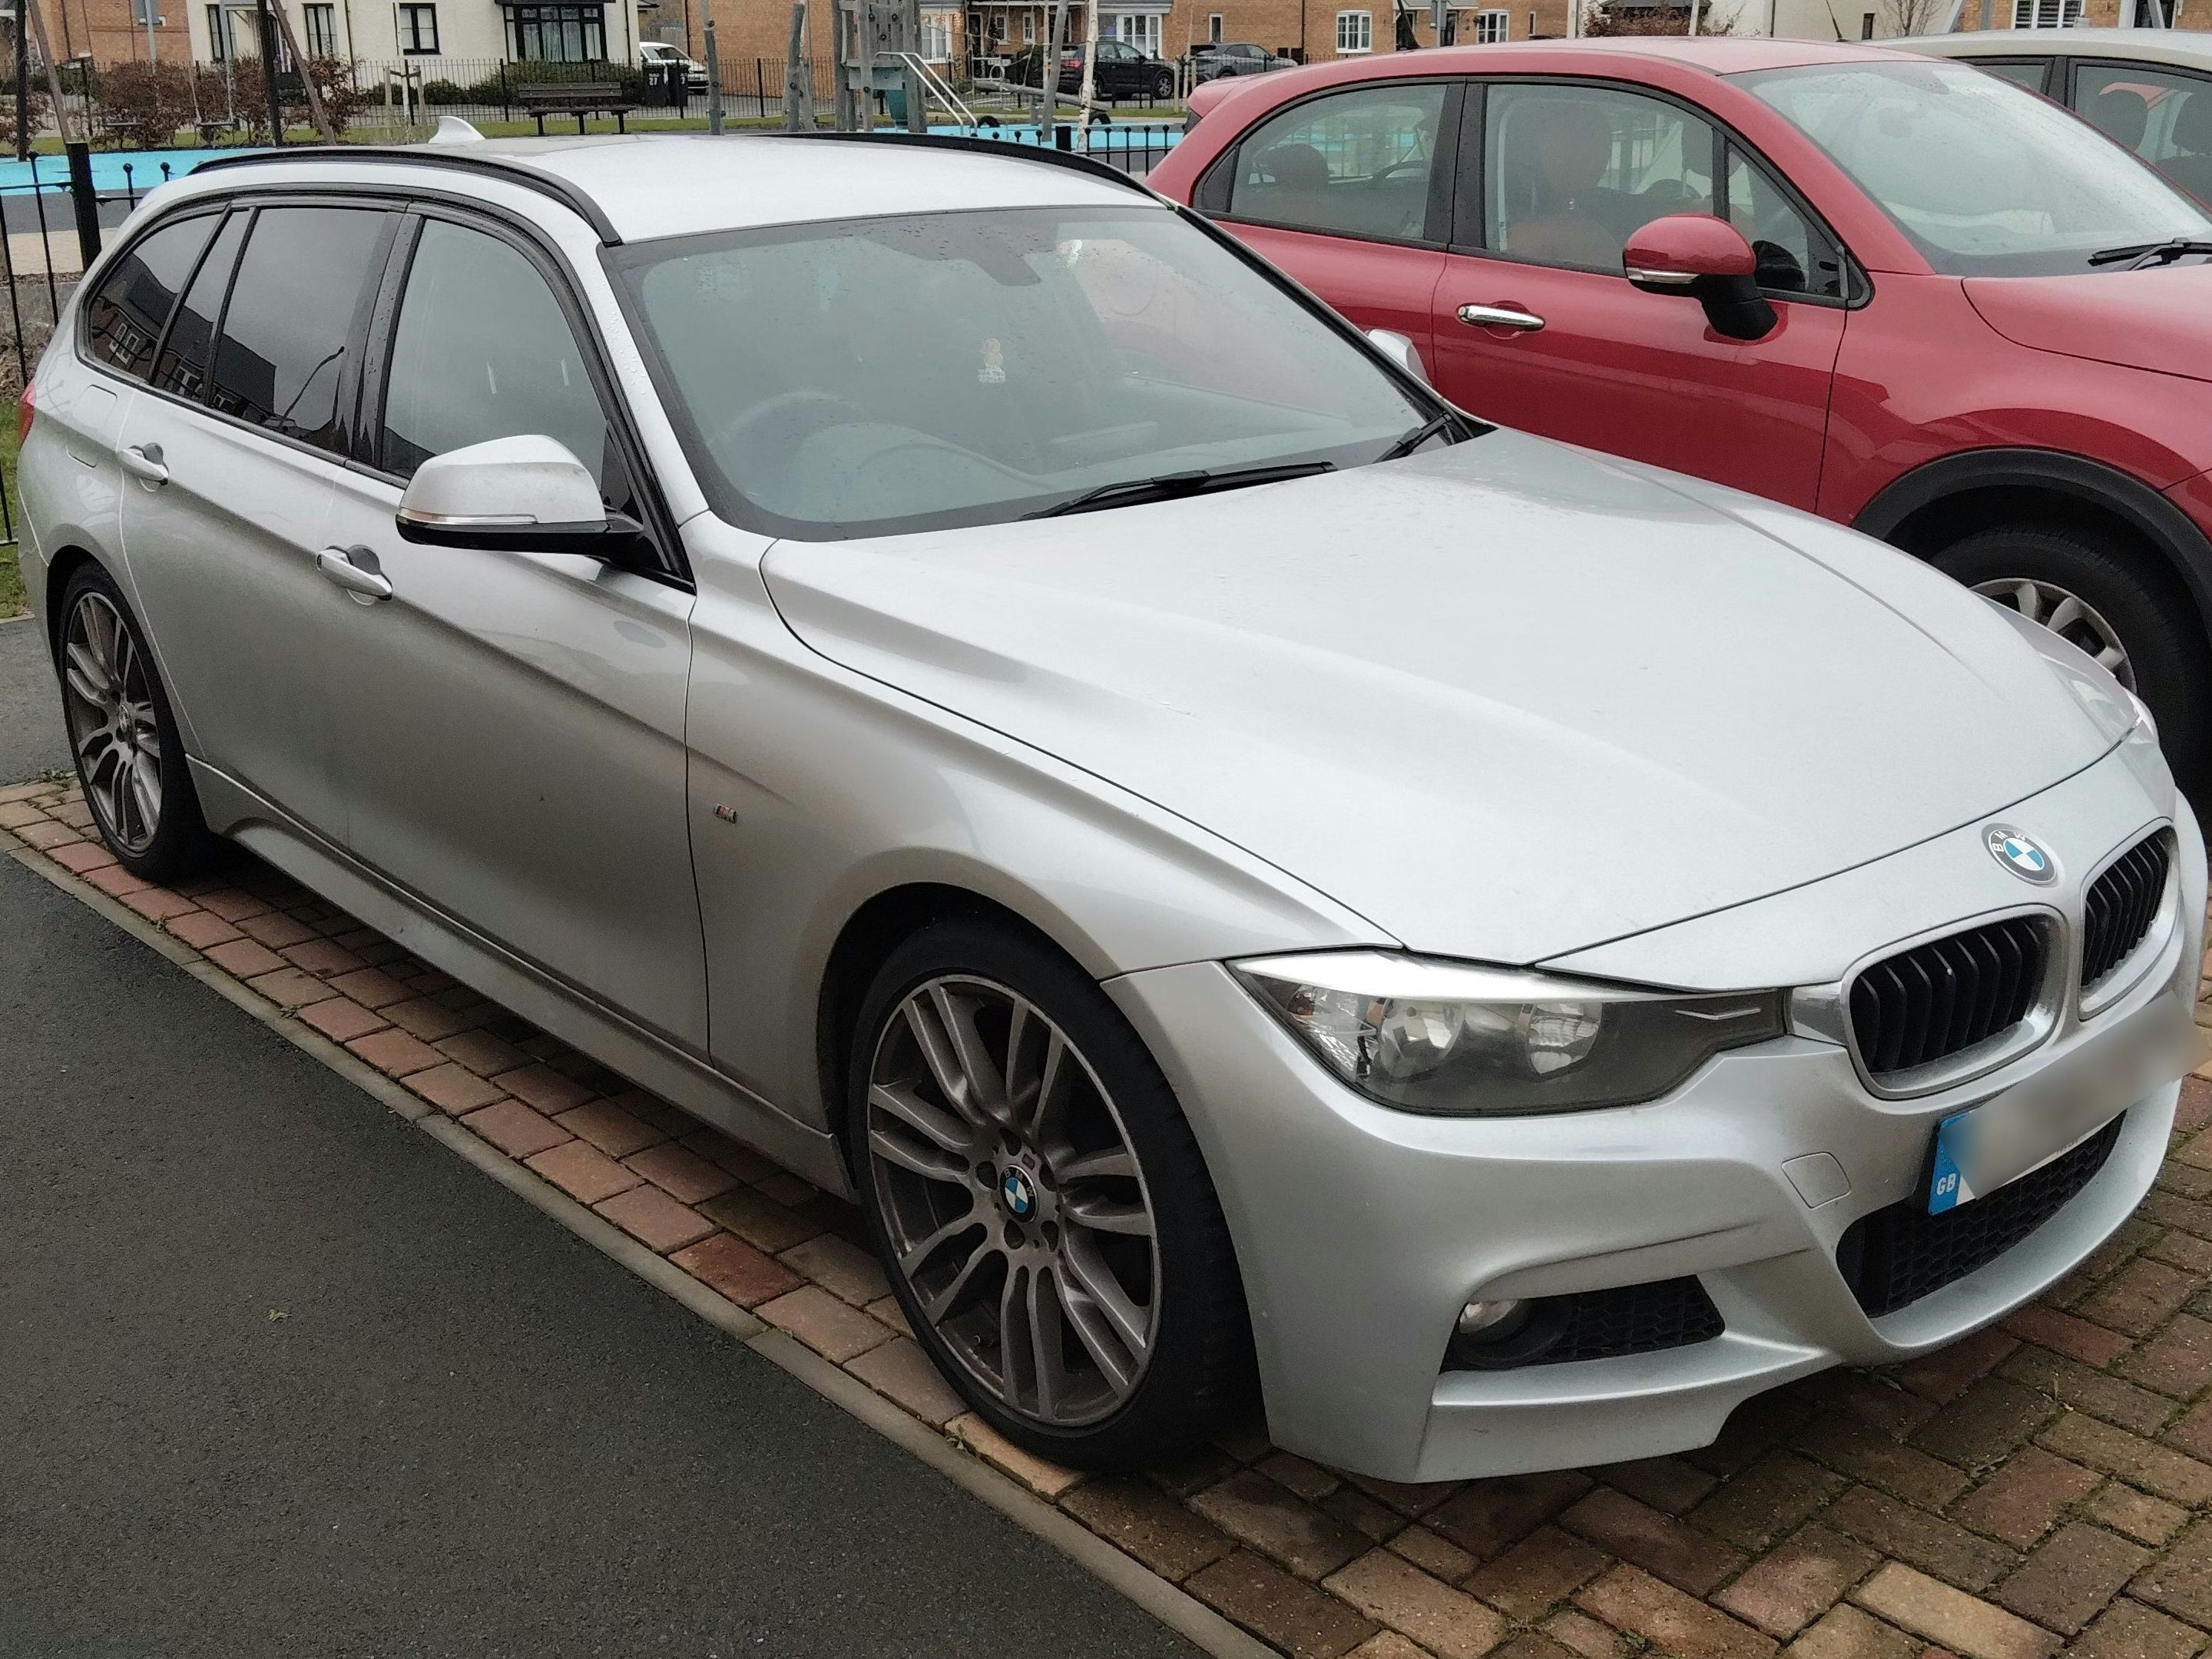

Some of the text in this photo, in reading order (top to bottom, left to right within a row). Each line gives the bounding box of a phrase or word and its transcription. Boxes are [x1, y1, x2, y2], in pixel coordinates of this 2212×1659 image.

[649, 77, 658, 86] 27
[1992, 830, 2027, 853] BMW
[1003, 1167, 1035, 1197] BMW
[1936, 1173, 1956, 1196] GB
